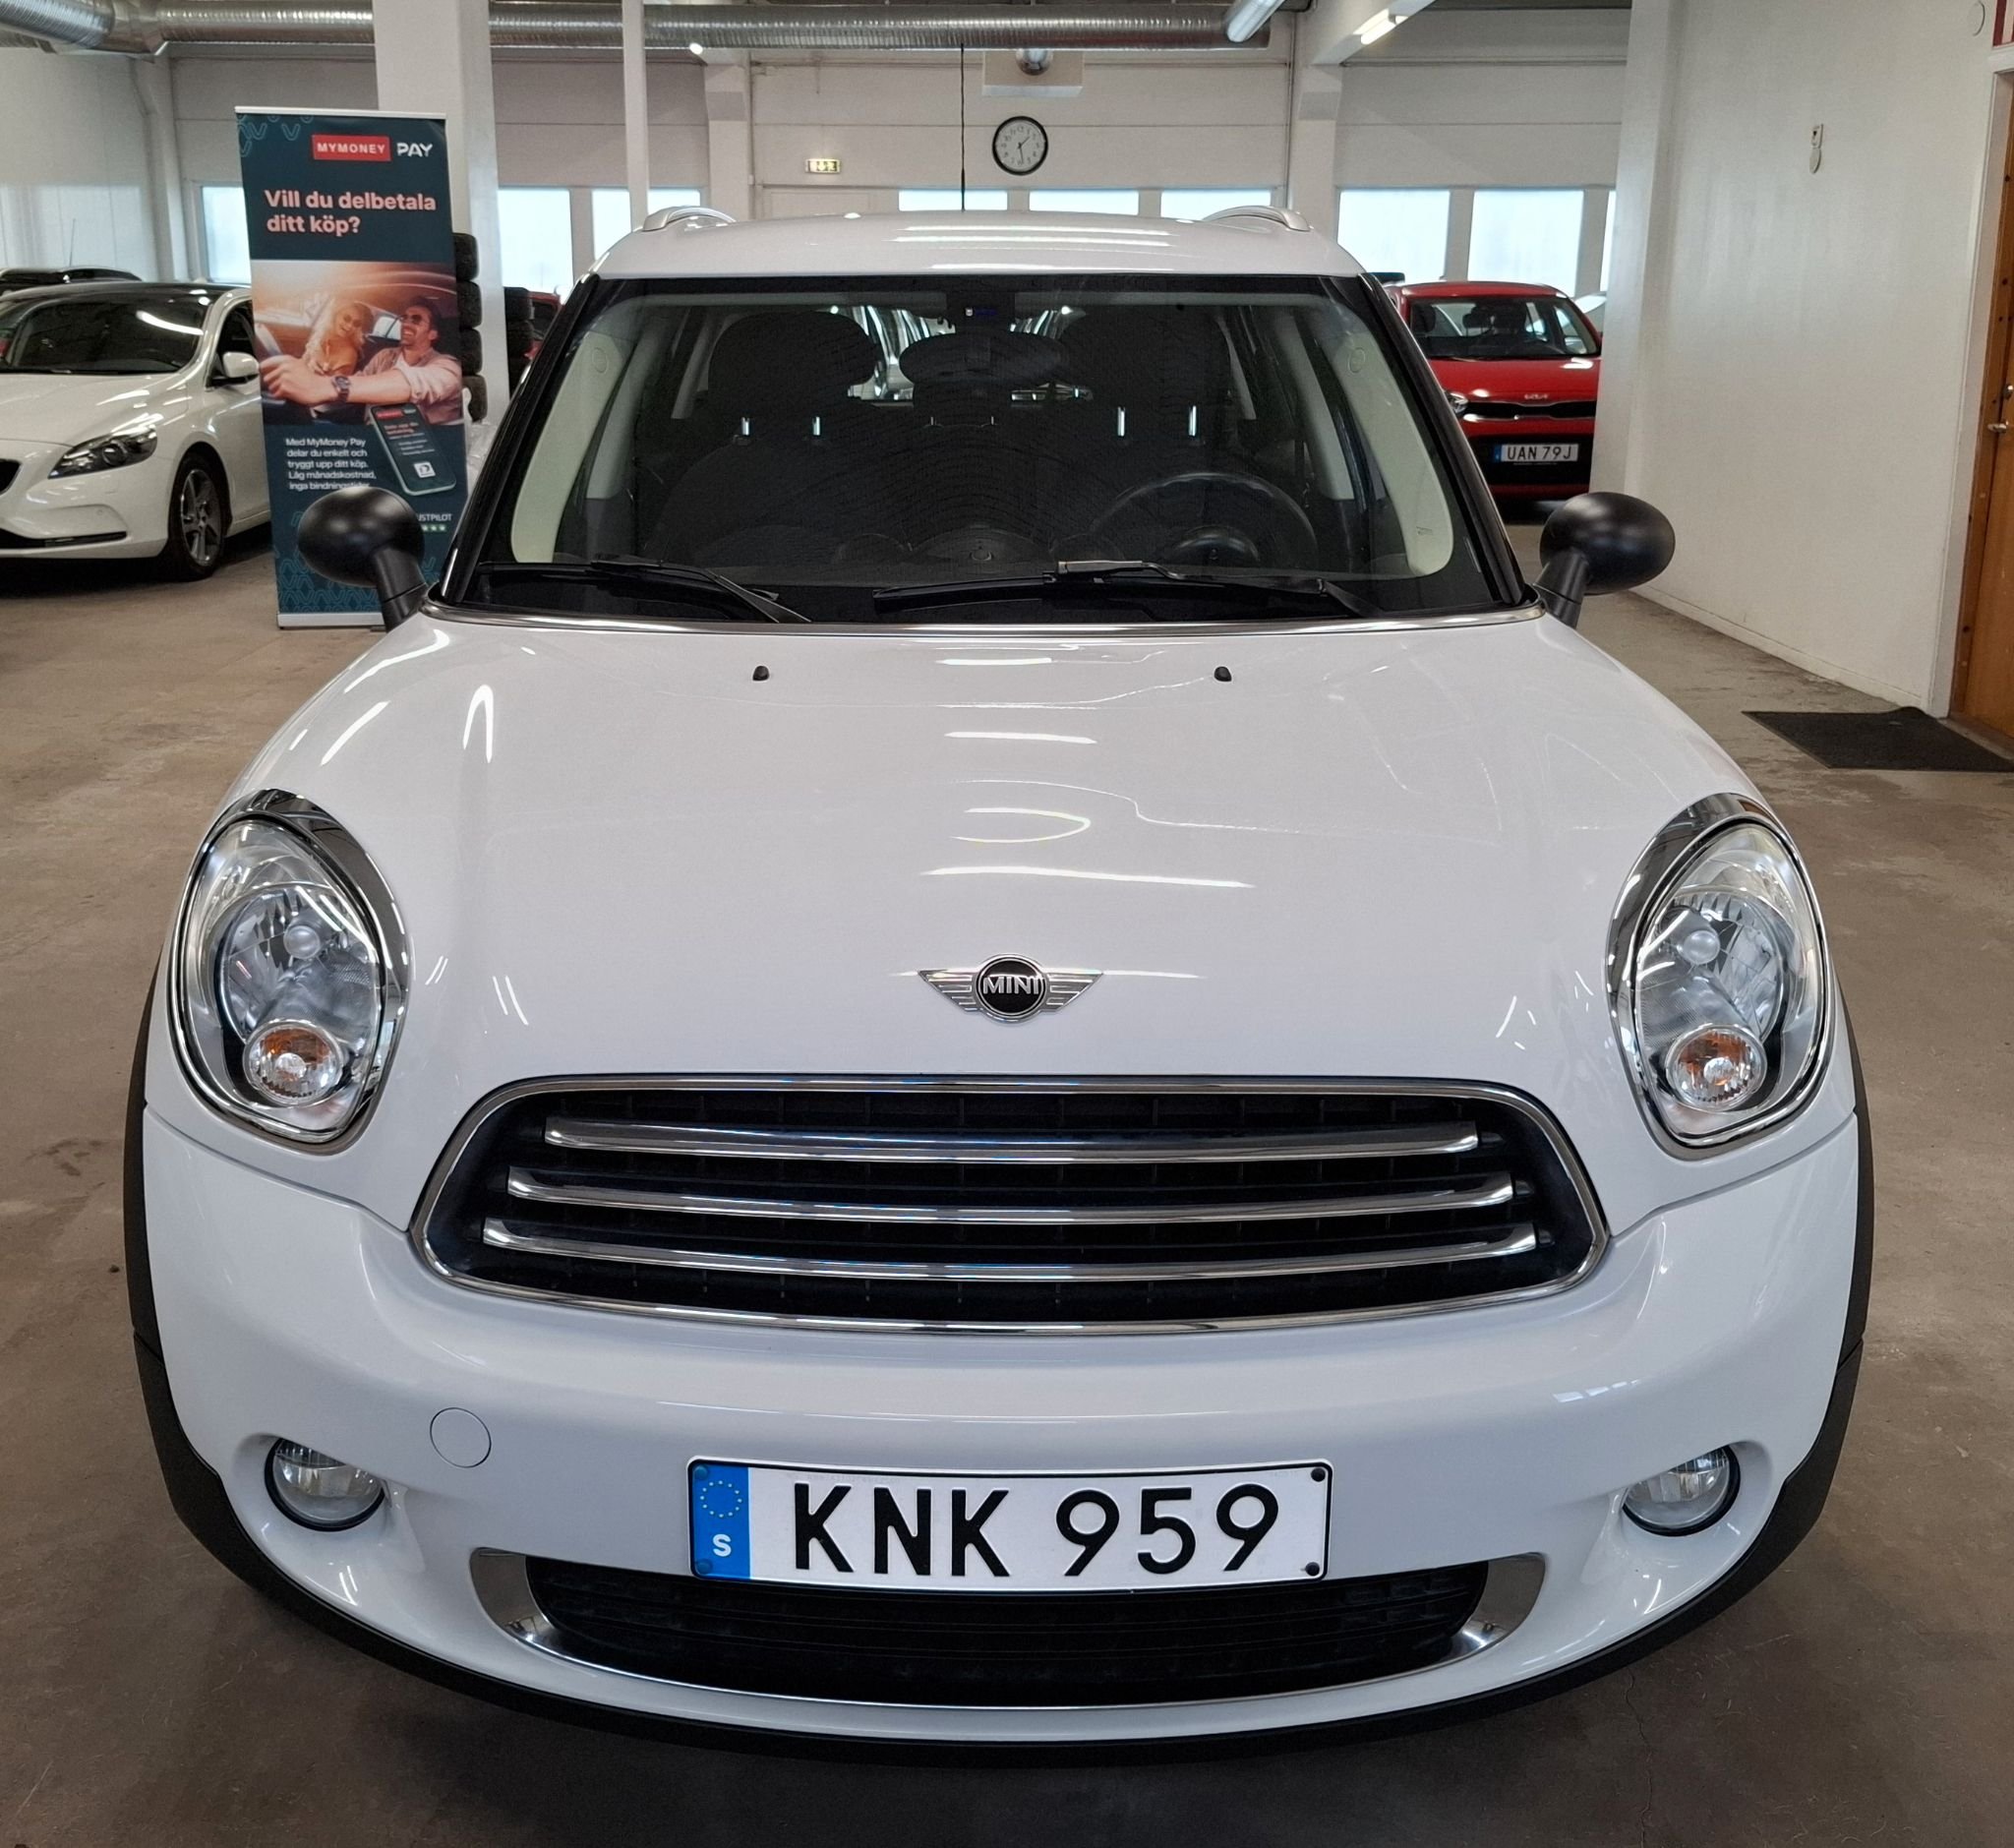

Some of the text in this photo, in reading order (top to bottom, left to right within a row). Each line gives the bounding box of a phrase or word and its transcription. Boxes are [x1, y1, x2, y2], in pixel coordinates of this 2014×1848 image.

[317, 142, 434, 157] MYMONEY PAY
[265, 189, 437, 210] Vill du delbetala
[267, 214, 361, 237] ditt köp?
[285, 438, 366, 447] Med MyMoney Pay
[286, 448, 309, 457] delar
[1507, 447, 1538, 460] UAN
[1541, 447, 1572, 460] 79J
[287, 459, 314, 469] tryggt
[316, 460, 333, 469] upp
[350, 459, 369, 469] köp.
[288, 471, 305, 480] Låg
[982, 976, 1040, 995] MINI
[712, 1482, 1279, 1578] S KNK 959
